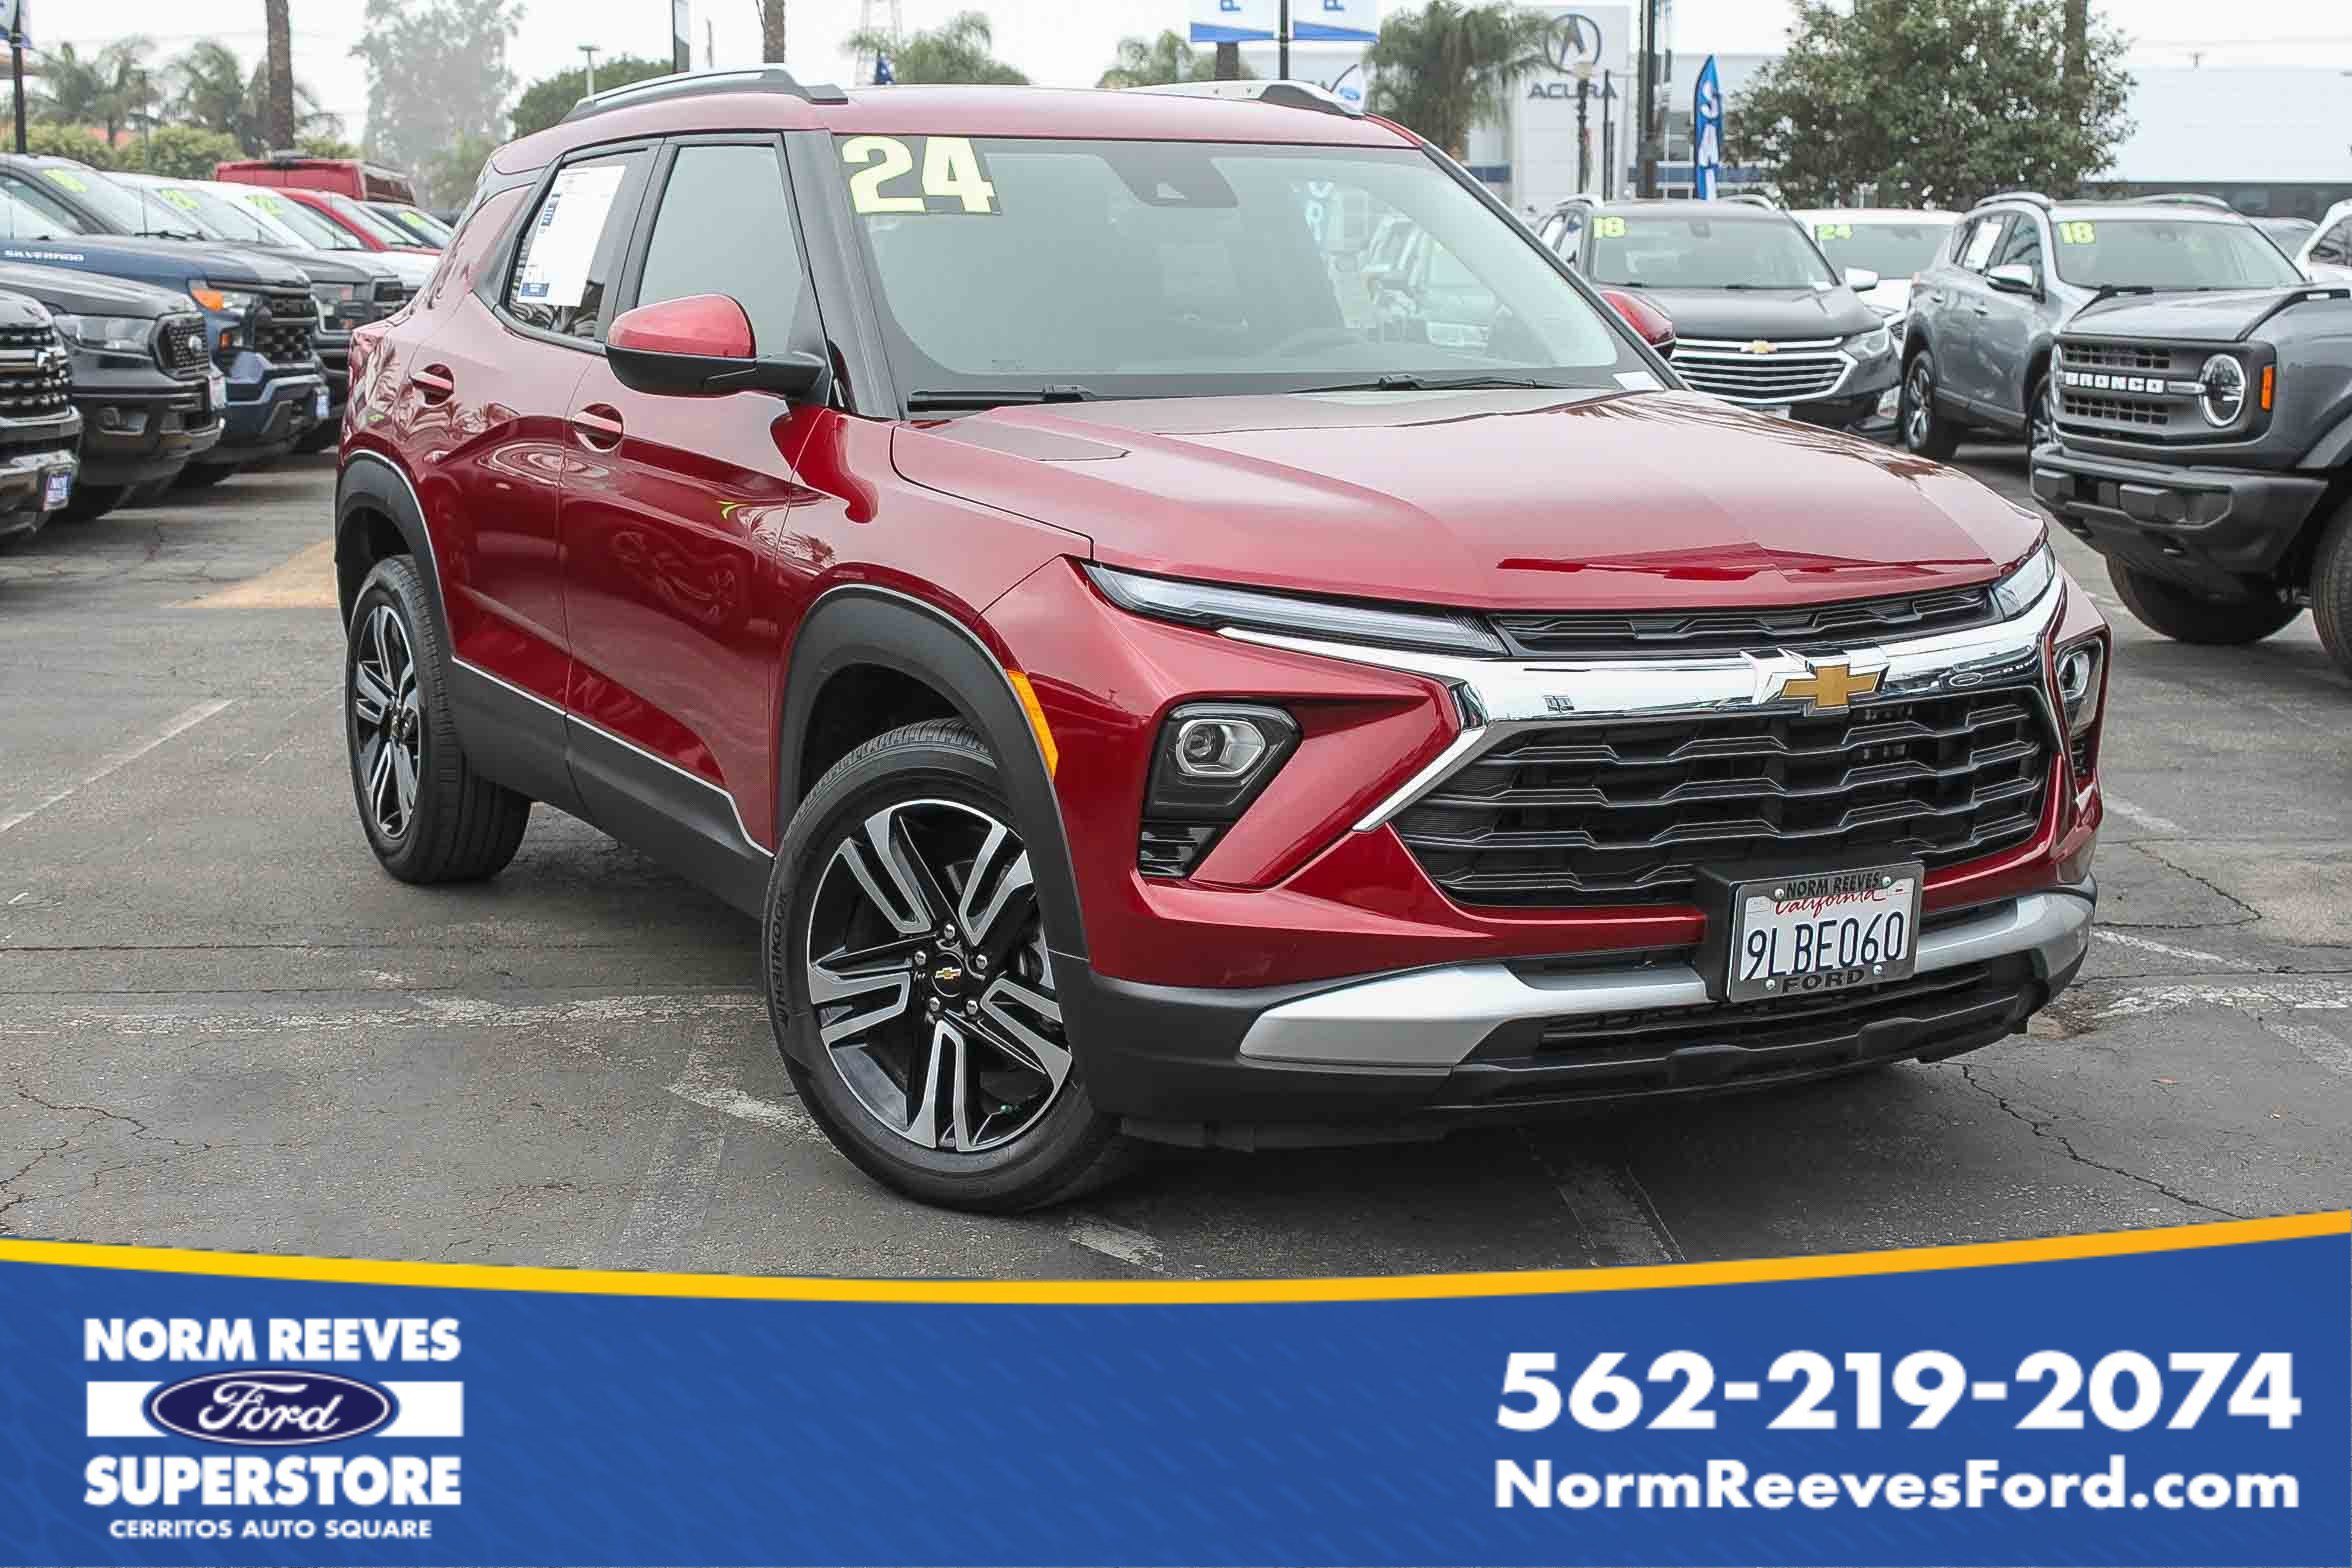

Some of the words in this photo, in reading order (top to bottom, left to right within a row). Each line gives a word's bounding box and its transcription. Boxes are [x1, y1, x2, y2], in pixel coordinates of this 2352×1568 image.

[1527, 82, 1618, 99] ACURA
[841, 135, 996, 214] 24
[2057, 221, 2096, 244] 18
[2064, 371, 2165, 394] BRONCO
[1786, 879, 1829, 898] NORM
[1832, 871, 1881, 895] REEVES
[1775, 887, 1887, 919] California
[1747, 911, 1905, 981] 9LBE060
[1782, 969, 1866, 993] FORD
